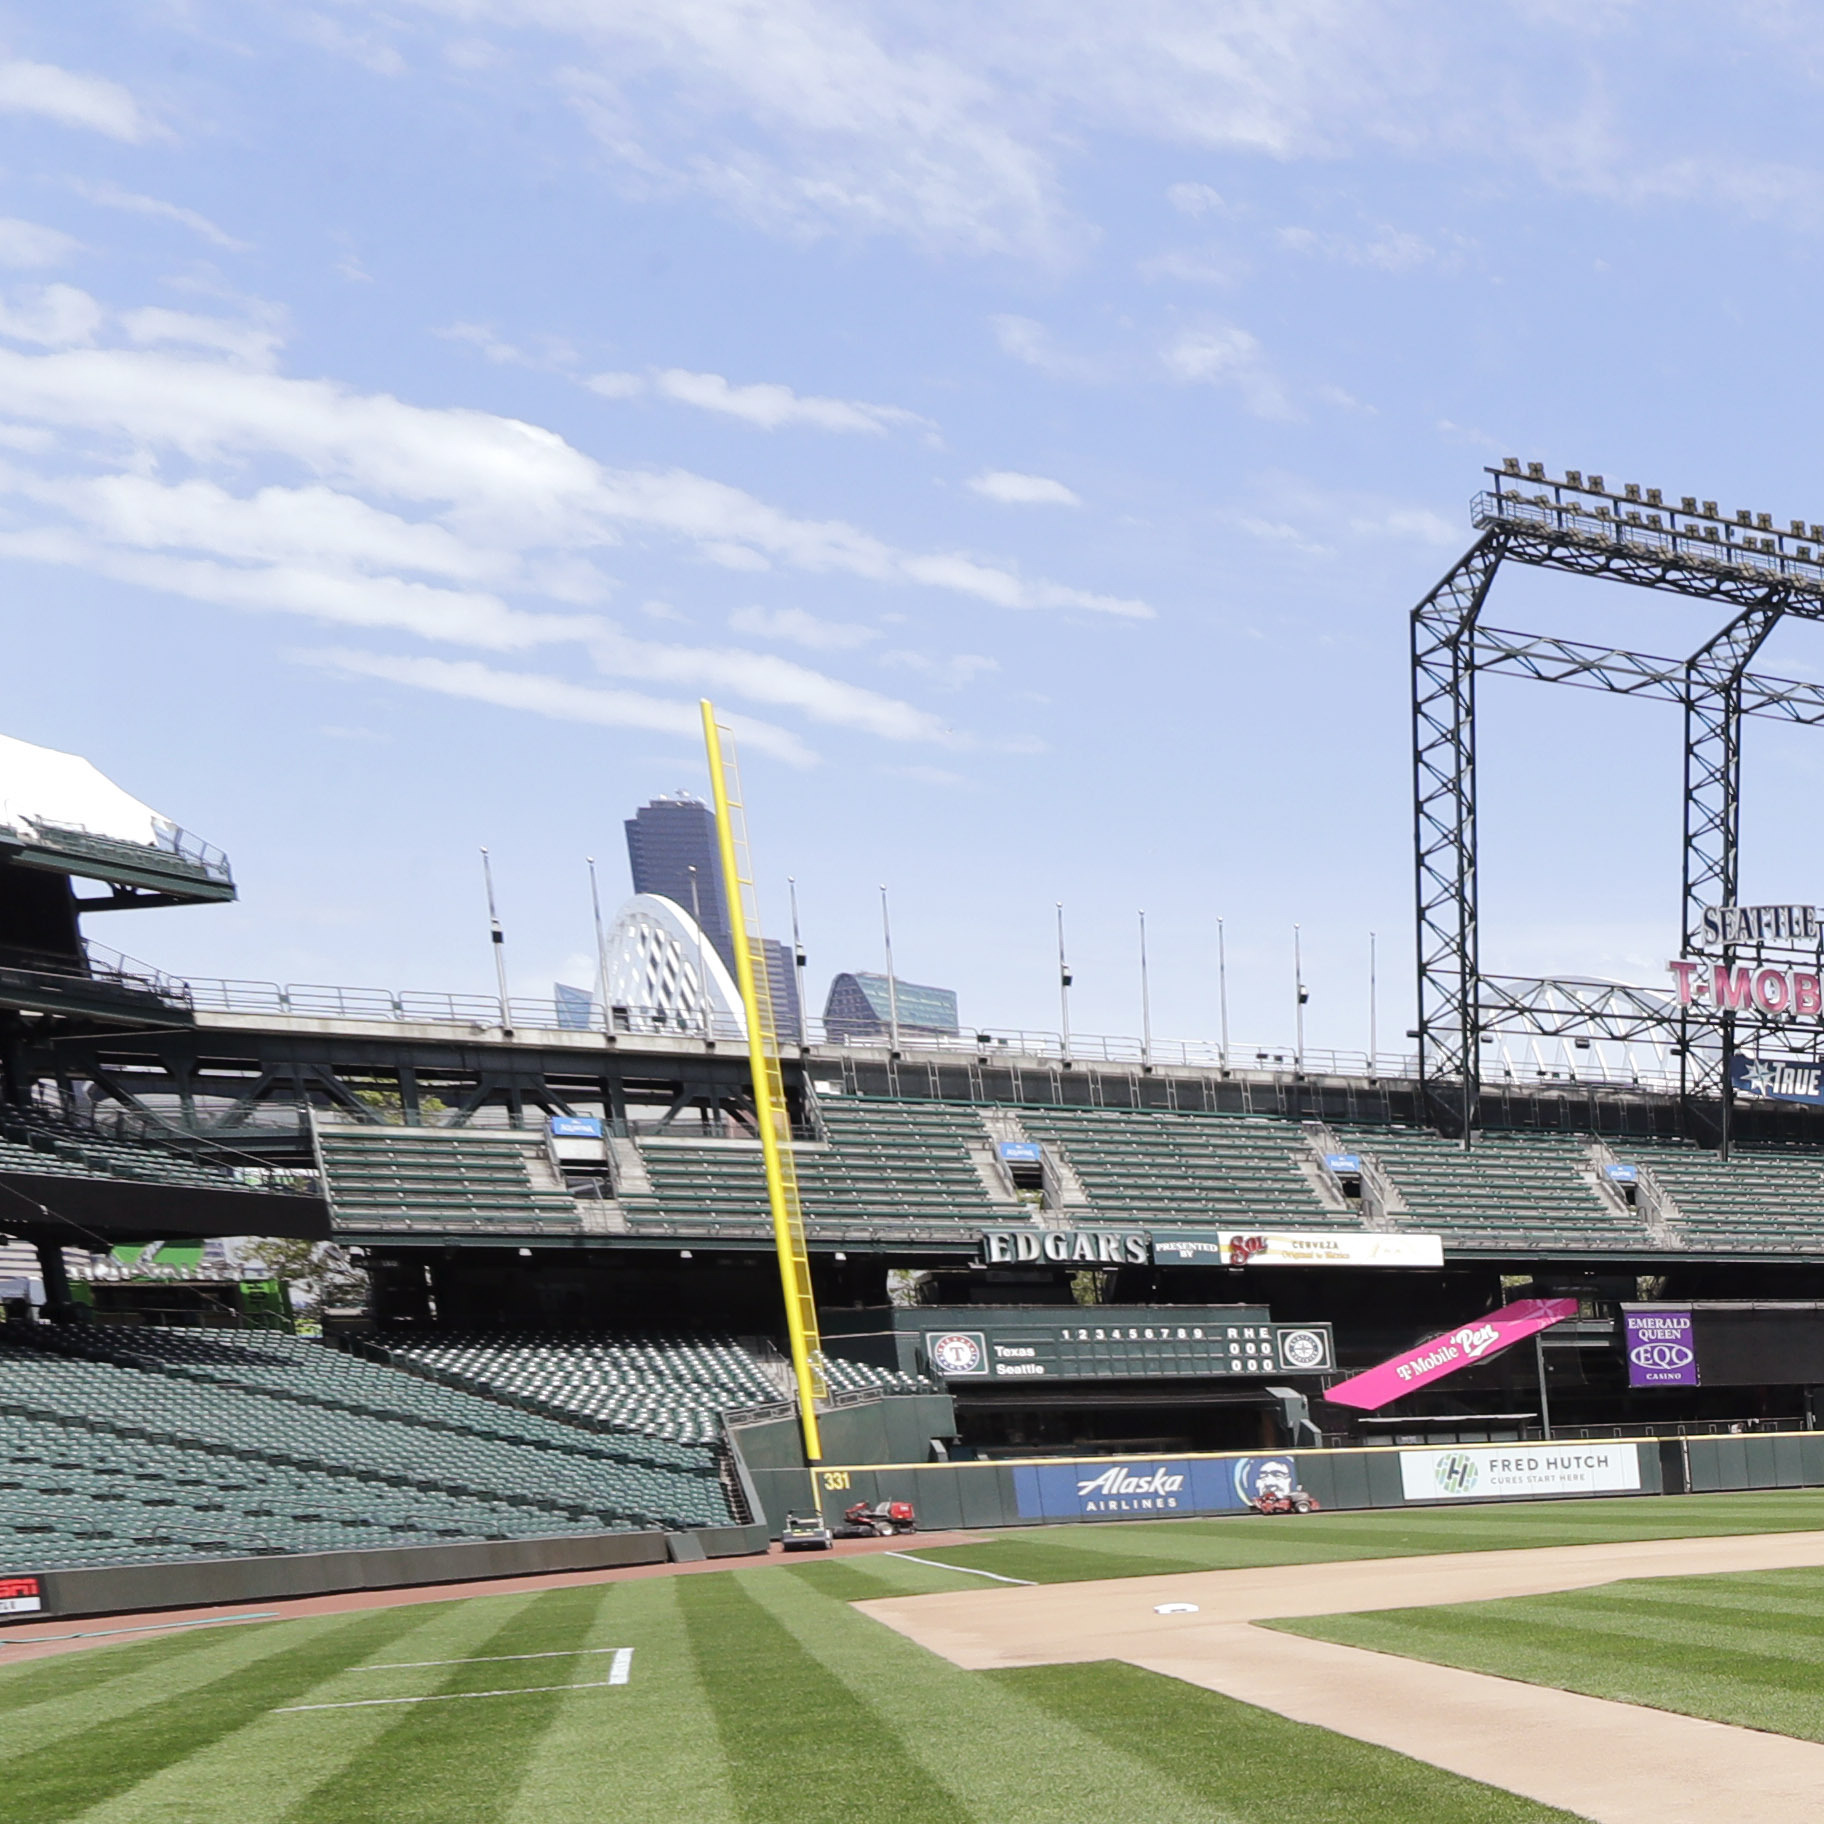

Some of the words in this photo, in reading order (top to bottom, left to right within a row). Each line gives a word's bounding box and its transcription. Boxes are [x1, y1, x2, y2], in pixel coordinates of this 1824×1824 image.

[1701, 904, 1818, 945] SEATTLE
[1772, 1061, 1821, 1097] TRUE
[1155, 1240, 1219, 1253] PRESENTED
[1292, 1240, 1339, 1251] CERVEZA
[1180, 1249, 1194, 1259] BY
[1627, 1317, 1690, 1329] EMERALD
[1078, 1330, 1088, 1340] 2
[1095, 1330, 1105, 1340] 3
[1112, 1330, 1121, 1339] 4
[1129, 1329, 1138, 1339] 5
[1145, 1329, 1154, 1339] 6
[1160, 1329, 1169, 1339] 7
[1177, 1329, 1187, 1339] 8
[1193, 1328, 1202, 1339] 9
[1227, 1328, 1238, 1339] R
[1244, 1328, 1254, 1339] H
[1259, 1327, 1270, 1338] E
[1638, 1328, 1681, 1342] QUEEN
[994, 1346, 1035, 1358] Texas
[996, 1364, 1044, 1376] Seattle
[1645, 1372, 1682, 1380] CASINO
[1489, 1458, 1539, 1472] FRED
[1546, 1455, 1609, 1471] HUTCH
[823, 1472, 850, 1490] 331
[1077, 1467, 1184, 1496] Alaska
[1490, 1477, 1523, 1485] CURES
[1526, 1475, 1556, 1483] START
[1559, 1473, 1585, 1482] HERE
[1086, 1497, 1177, 1512] AIRLINES
